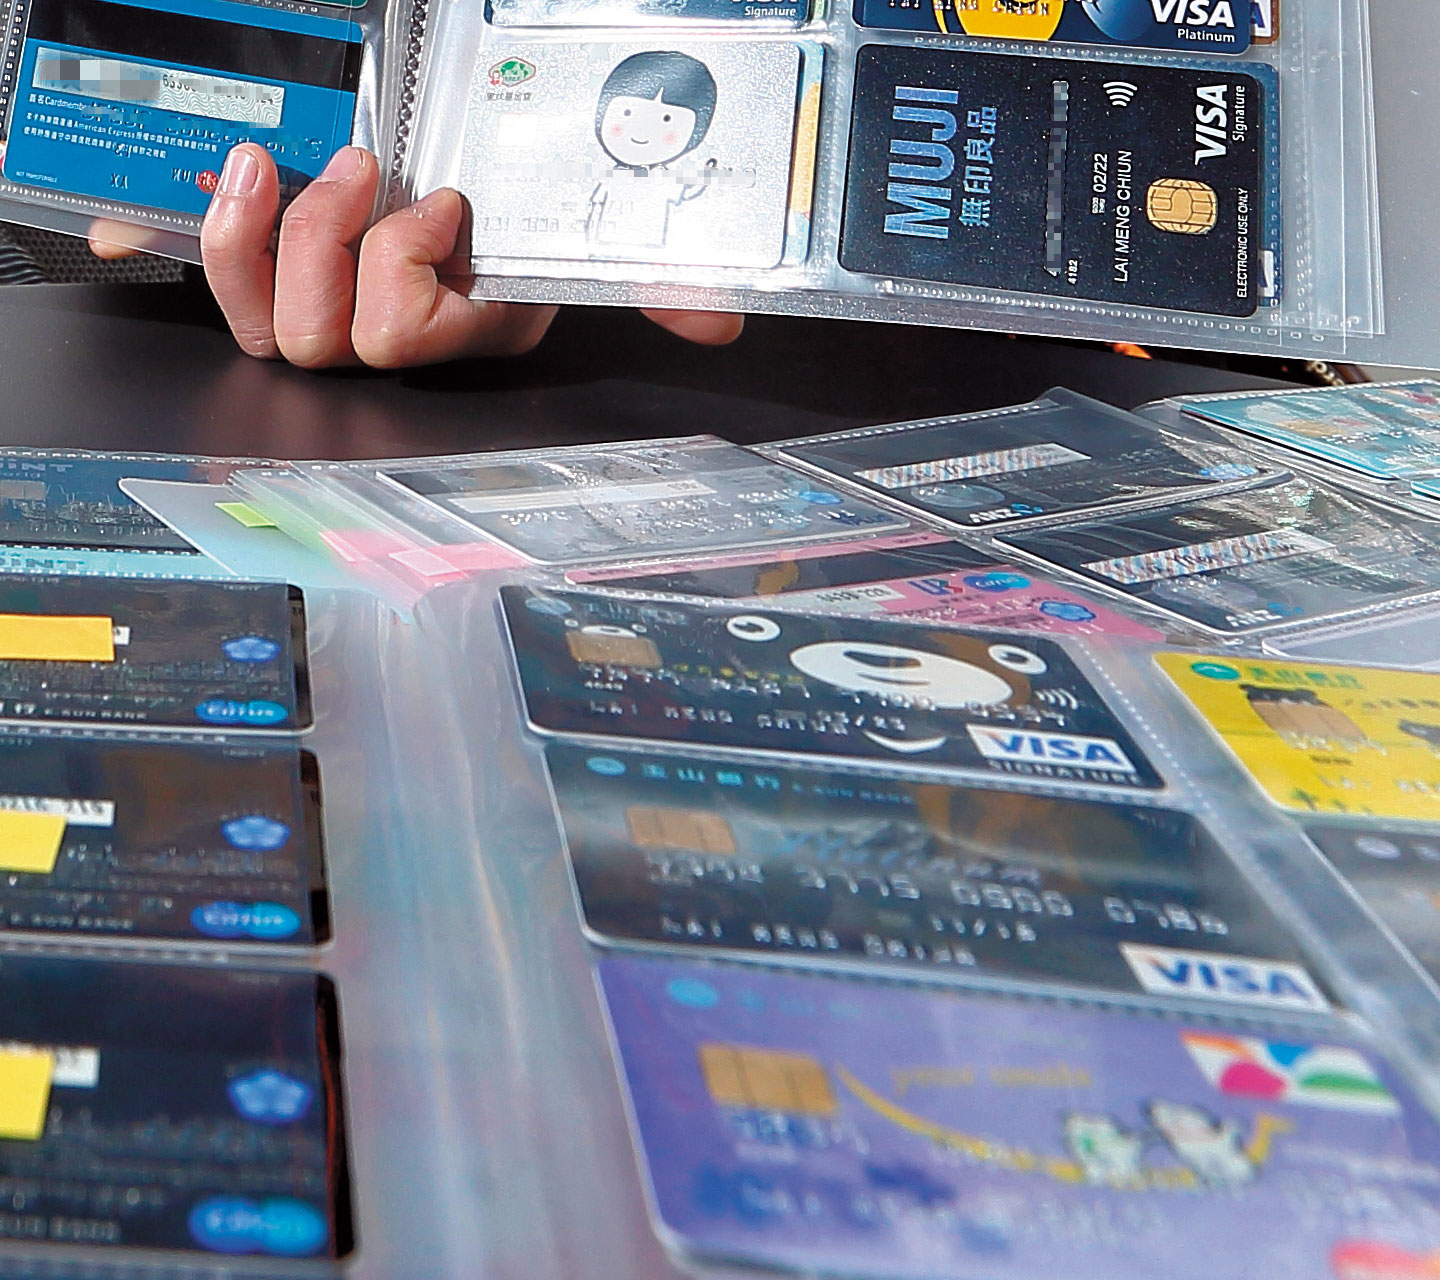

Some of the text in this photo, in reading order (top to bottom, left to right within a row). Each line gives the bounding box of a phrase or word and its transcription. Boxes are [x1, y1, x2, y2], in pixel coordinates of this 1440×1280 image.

[744, 5, 797, 18] Signature
[1177, 28, 1236, 43] Platinum
[1194, 84, 1229, 166] VISA
[1232, 85, 1246, 142] Signature
[883, 85, 959, 240] MUJI
[959, 106, 997, 227] 無印良品
[1093, 153, 1108, 194] 02/22
[1115, 150, 1133, 283] LAI MENG CHIUN
[1237, 187, 1248, 298] ELECTRONIC USE ONLY
[1067, 260, 1079, 285] 4182
[967, 508, 1013, 525] ANZ
[988, 731, 1123, 765] VISA
[1144, 955, 1318, 1001] VISA
